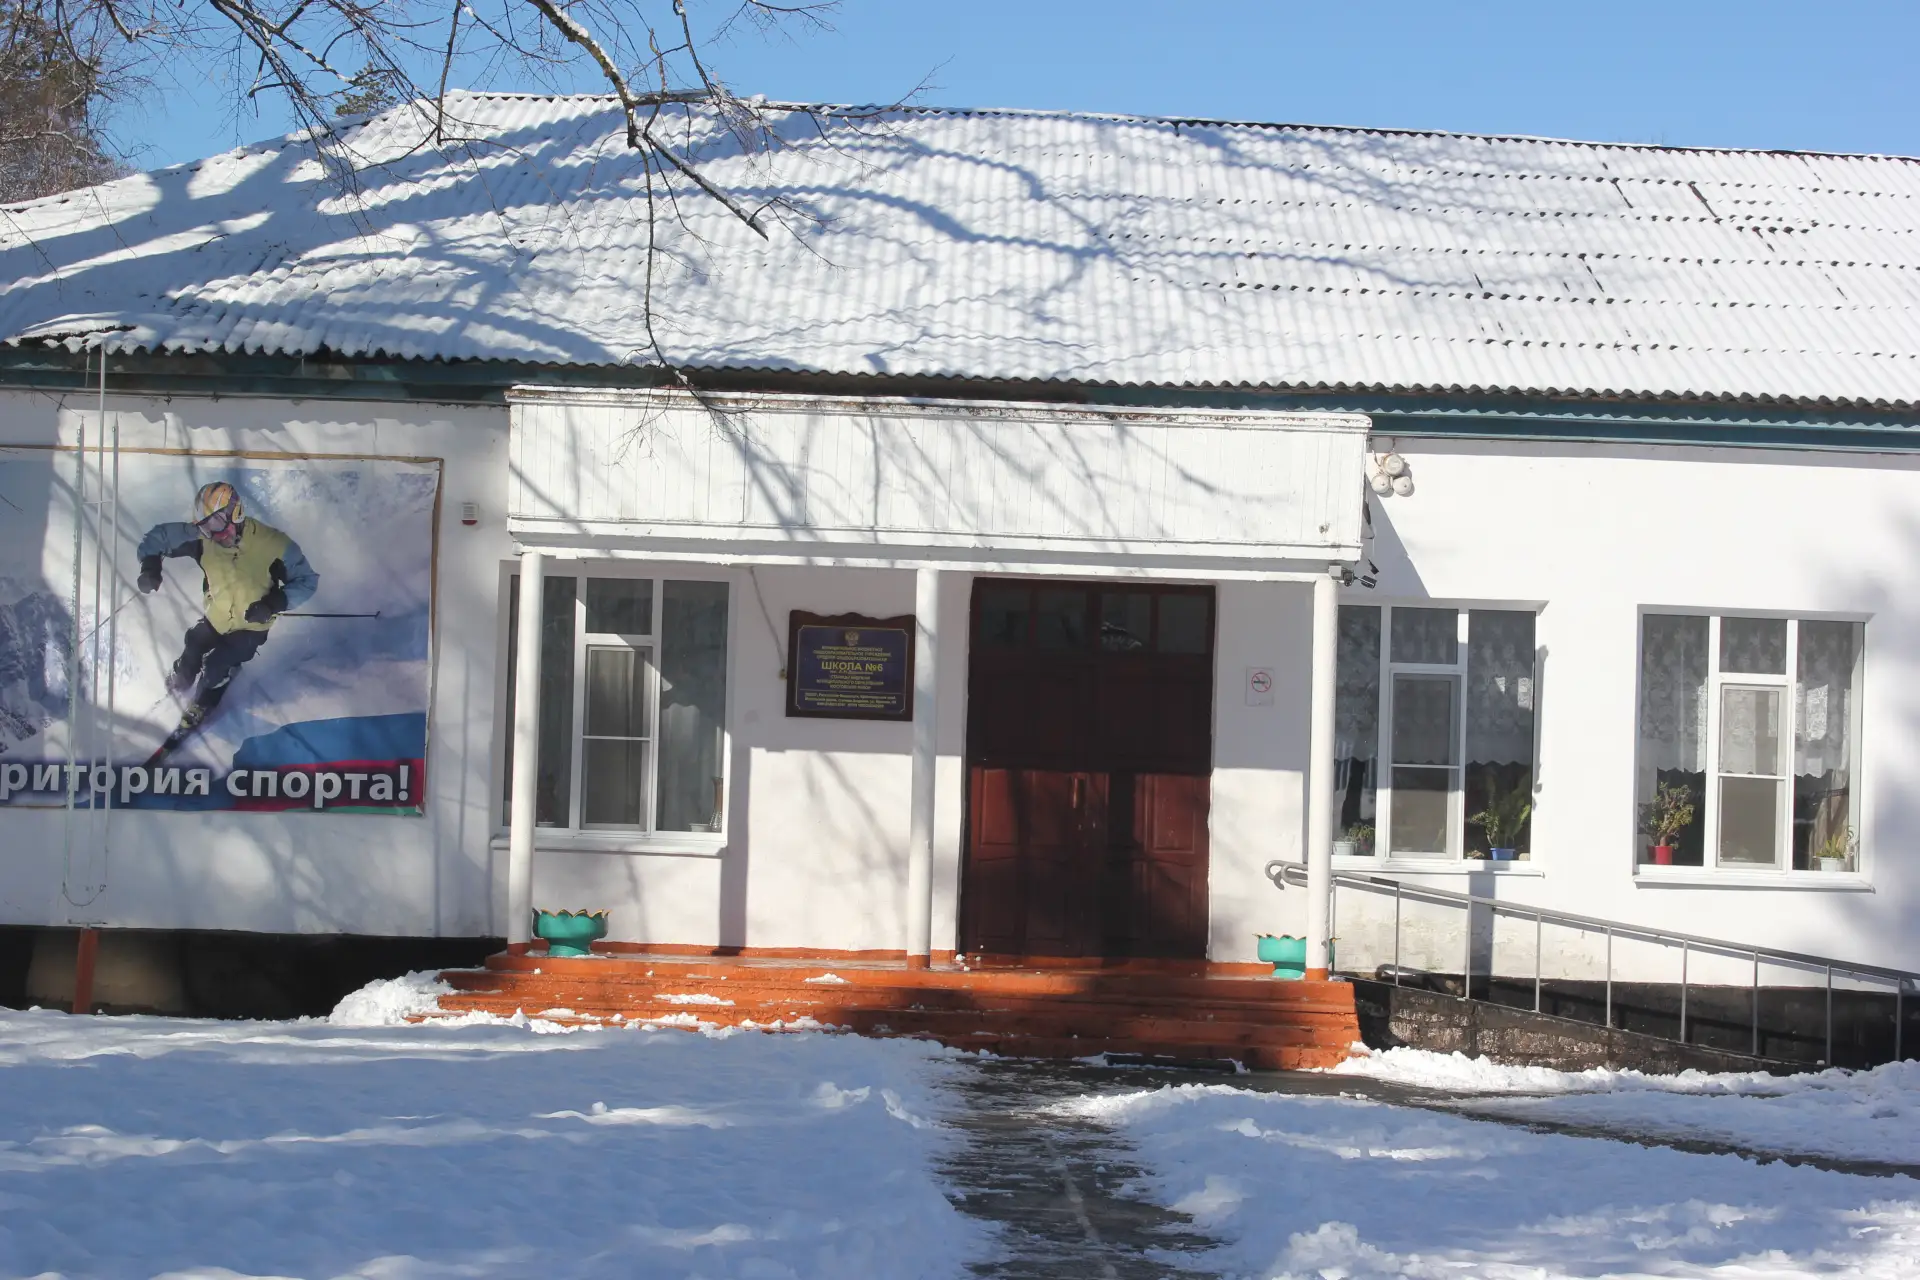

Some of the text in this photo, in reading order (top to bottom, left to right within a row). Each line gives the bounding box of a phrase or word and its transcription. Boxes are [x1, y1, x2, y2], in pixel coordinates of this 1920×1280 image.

[821, 661, 884, 672] ШКОЛА №6
[0, 763, 410, 808] ритория спорта!
